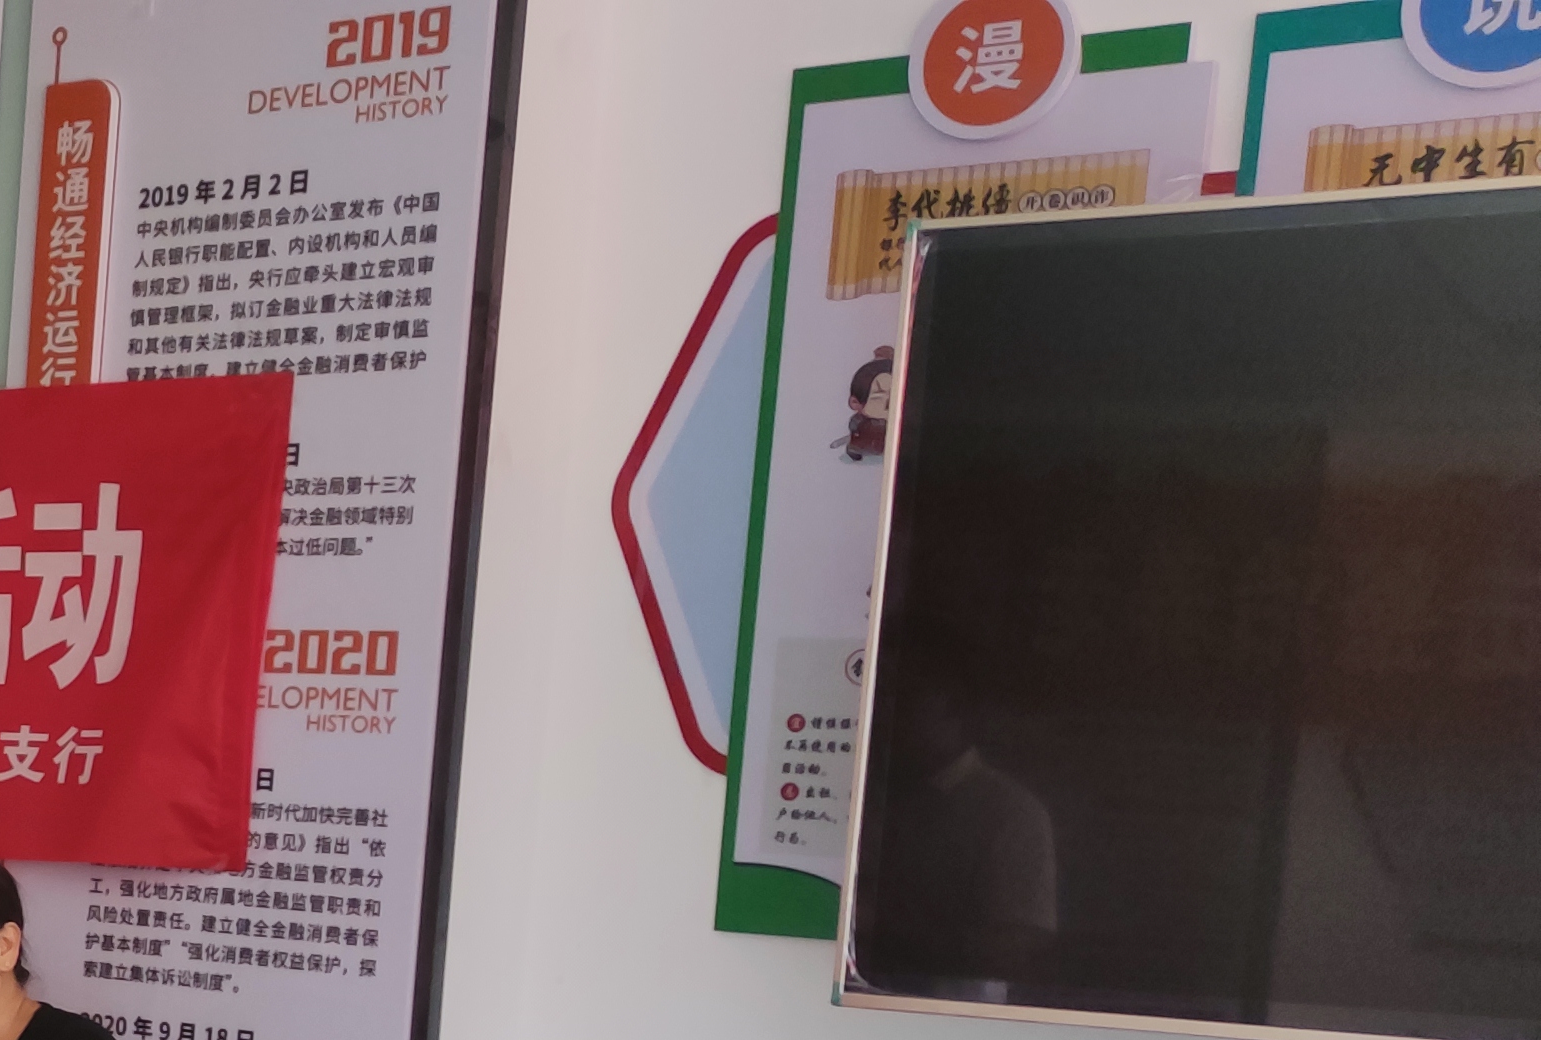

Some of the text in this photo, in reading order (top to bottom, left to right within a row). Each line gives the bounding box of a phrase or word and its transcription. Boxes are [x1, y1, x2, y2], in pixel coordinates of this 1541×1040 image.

[326, 5, 452, 68] 2019
[953, 19, 1024, 95] 漫
[248, 65, 451, 115] DEVELOPMENT
[355, 95, 449, 123] HISTORY
[39, 120, 95, 388] 畅通经济运行
[264, 629, 400, 677] 2020
[306, 714, 398, 735] HISTORY
[257, 767, 275, 792] 日
